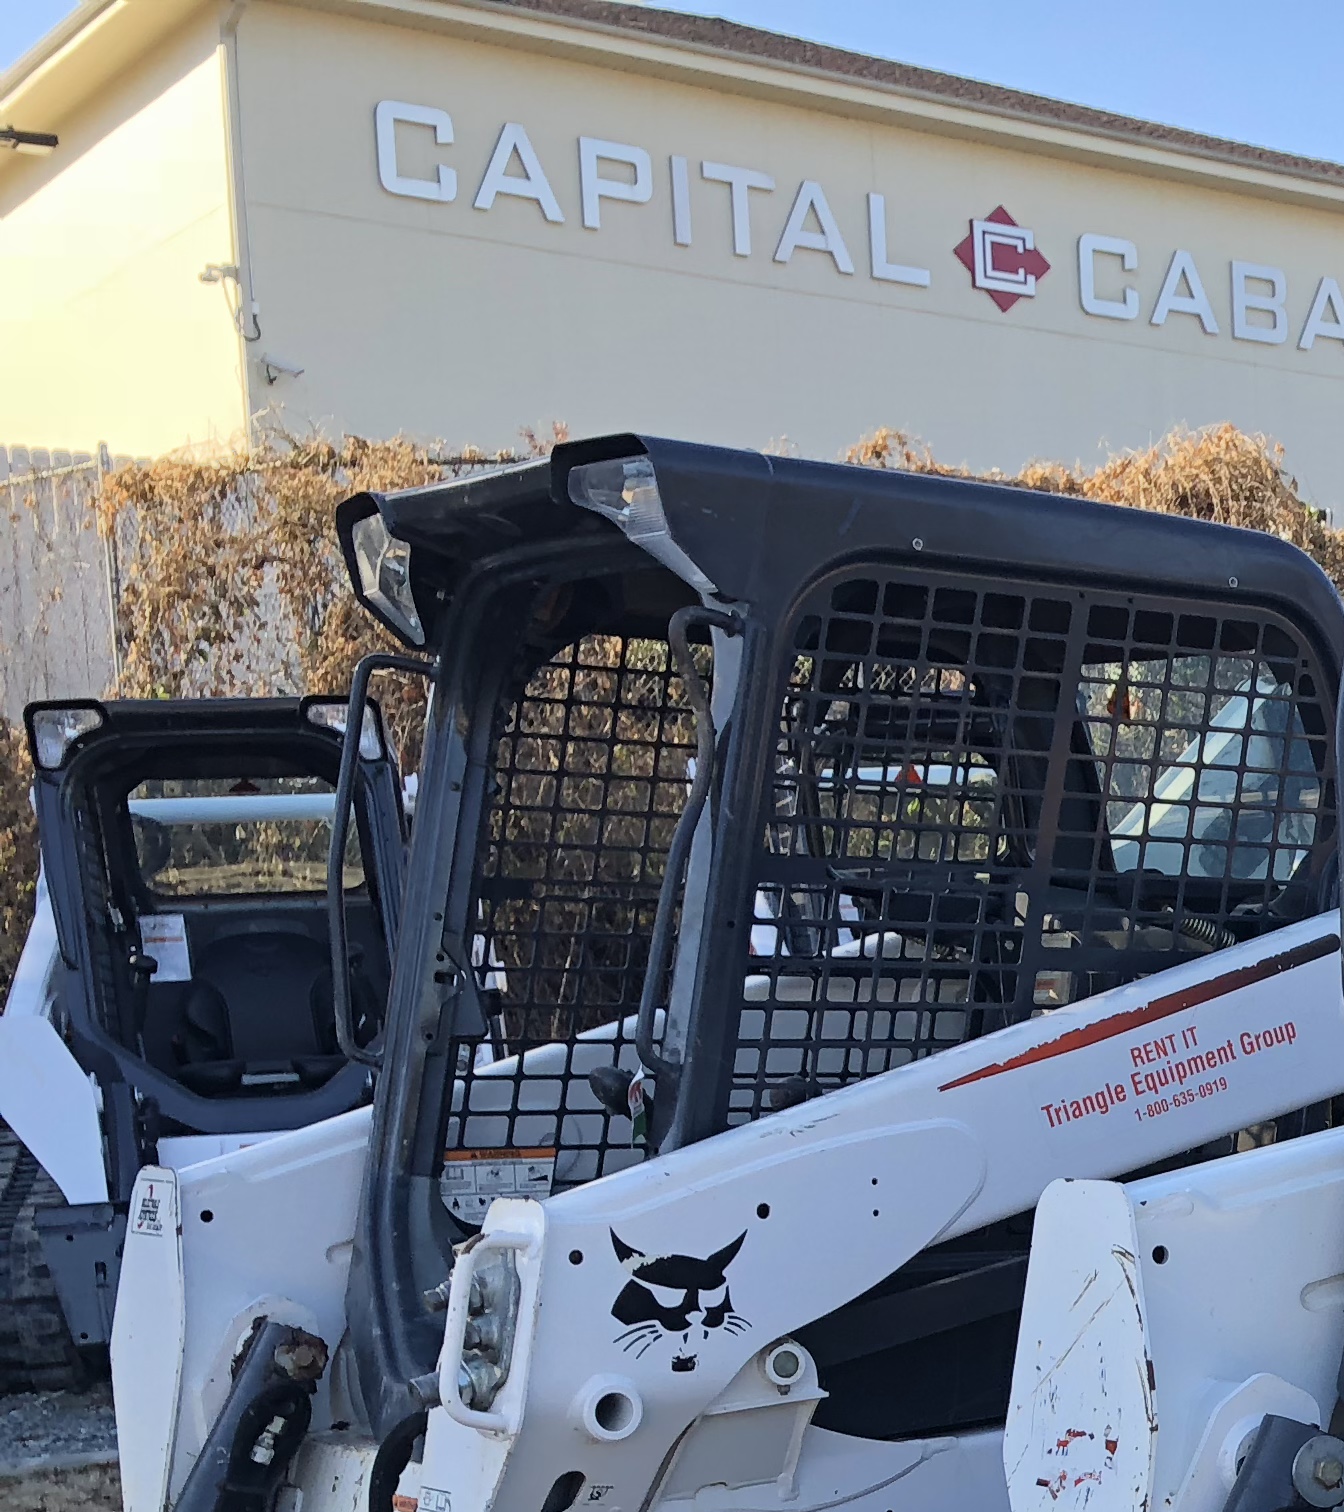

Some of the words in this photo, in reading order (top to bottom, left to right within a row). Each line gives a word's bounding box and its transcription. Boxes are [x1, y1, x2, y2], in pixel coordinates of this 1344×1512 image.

[376, 99, 931, 288] CAPITAL
[1040, 1085, 1127, 1129] Triangle
[1129, 1038, 1237, 1097] Equipment
[1239, 1020, 1298, 1058] Group
[1130, 1037, 1178, 1068] RENT
[1181, 1025, 1199, 1050] IT
[1133, 1076, 1229, 1122] 1-800-635-0919
